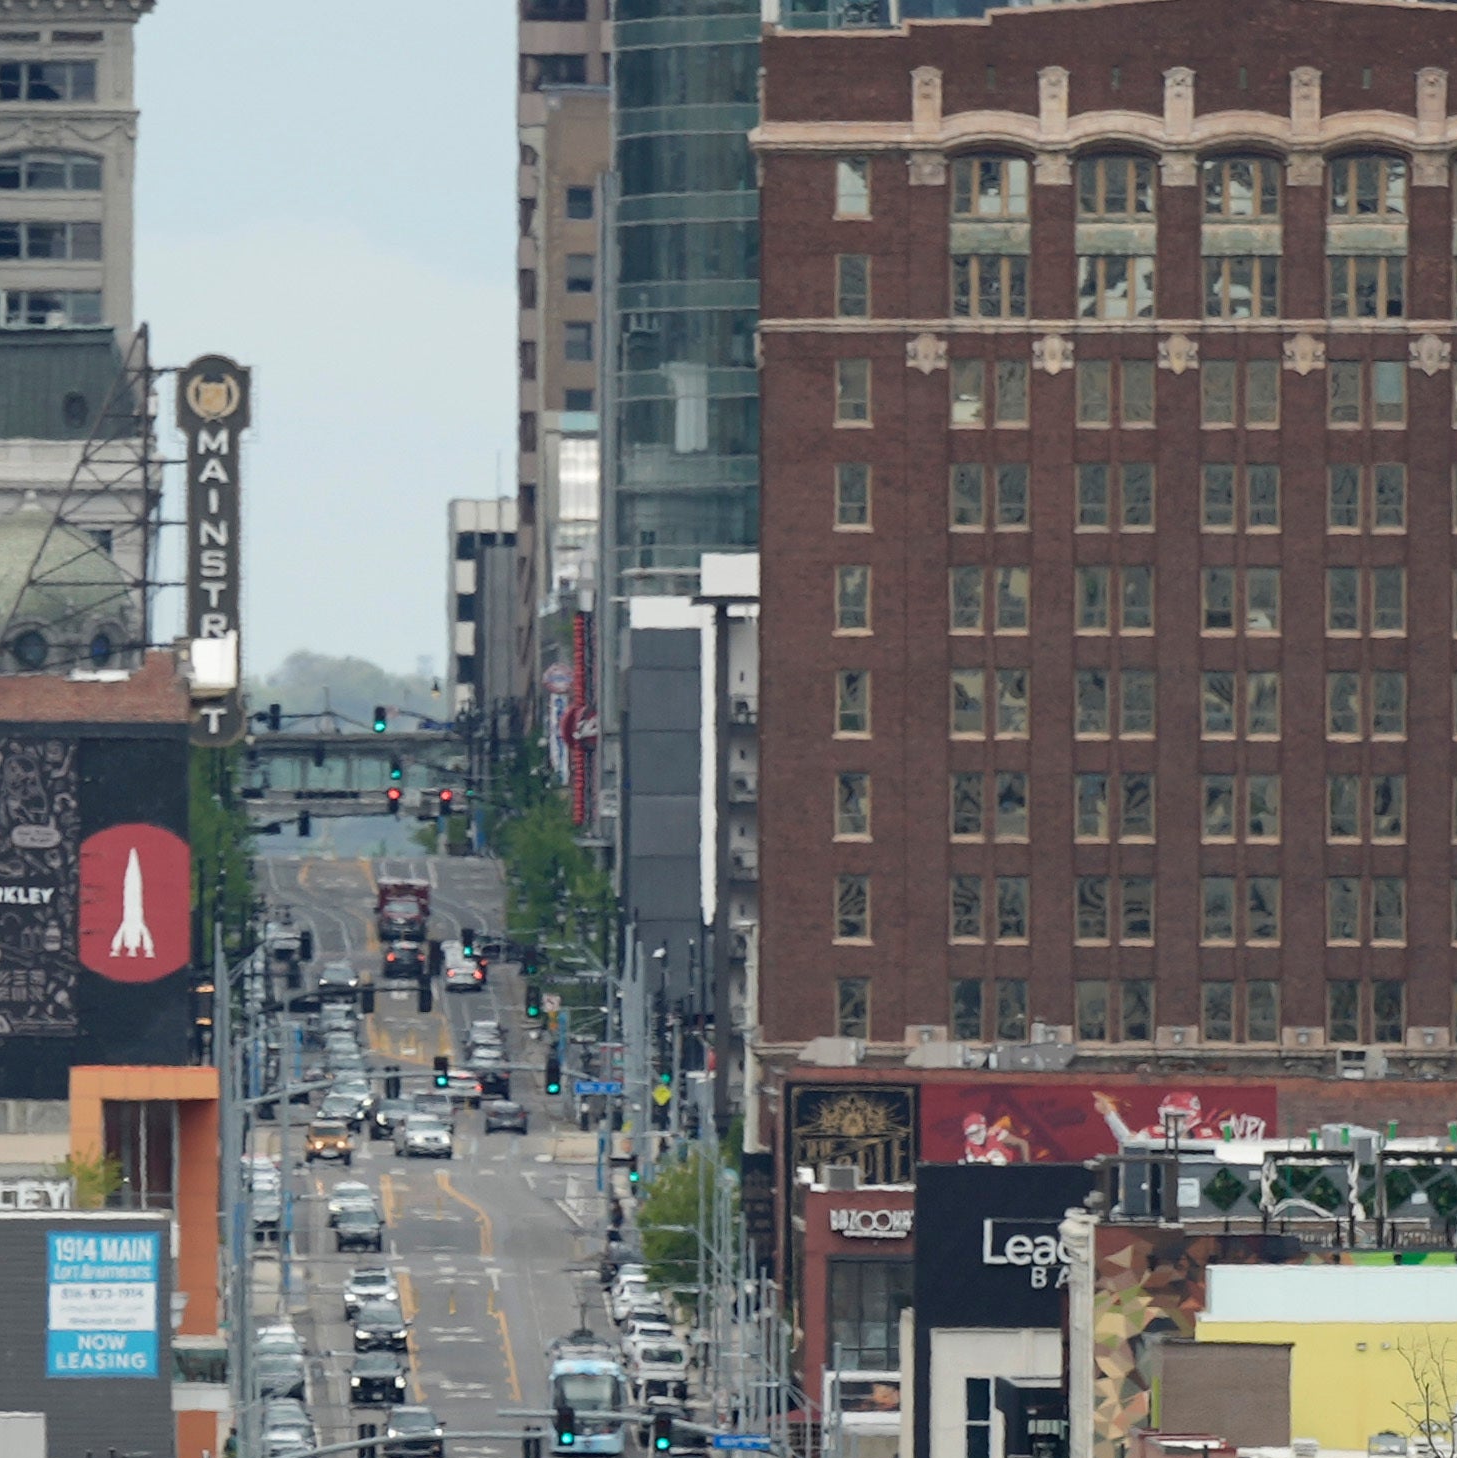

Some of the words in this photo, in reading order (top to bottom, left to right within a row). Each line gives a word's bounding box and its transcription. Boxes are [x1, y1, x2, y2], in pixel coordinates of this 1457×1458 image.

[196, 427, 230, 736] MAINSTRT
[55, 1237, 96, 1262] 1914
[101, 1237, 153, 1262] MAIN
[78, 1334, 128, 1351] NOW
[55, 1352, 148, 1370] LEASING
